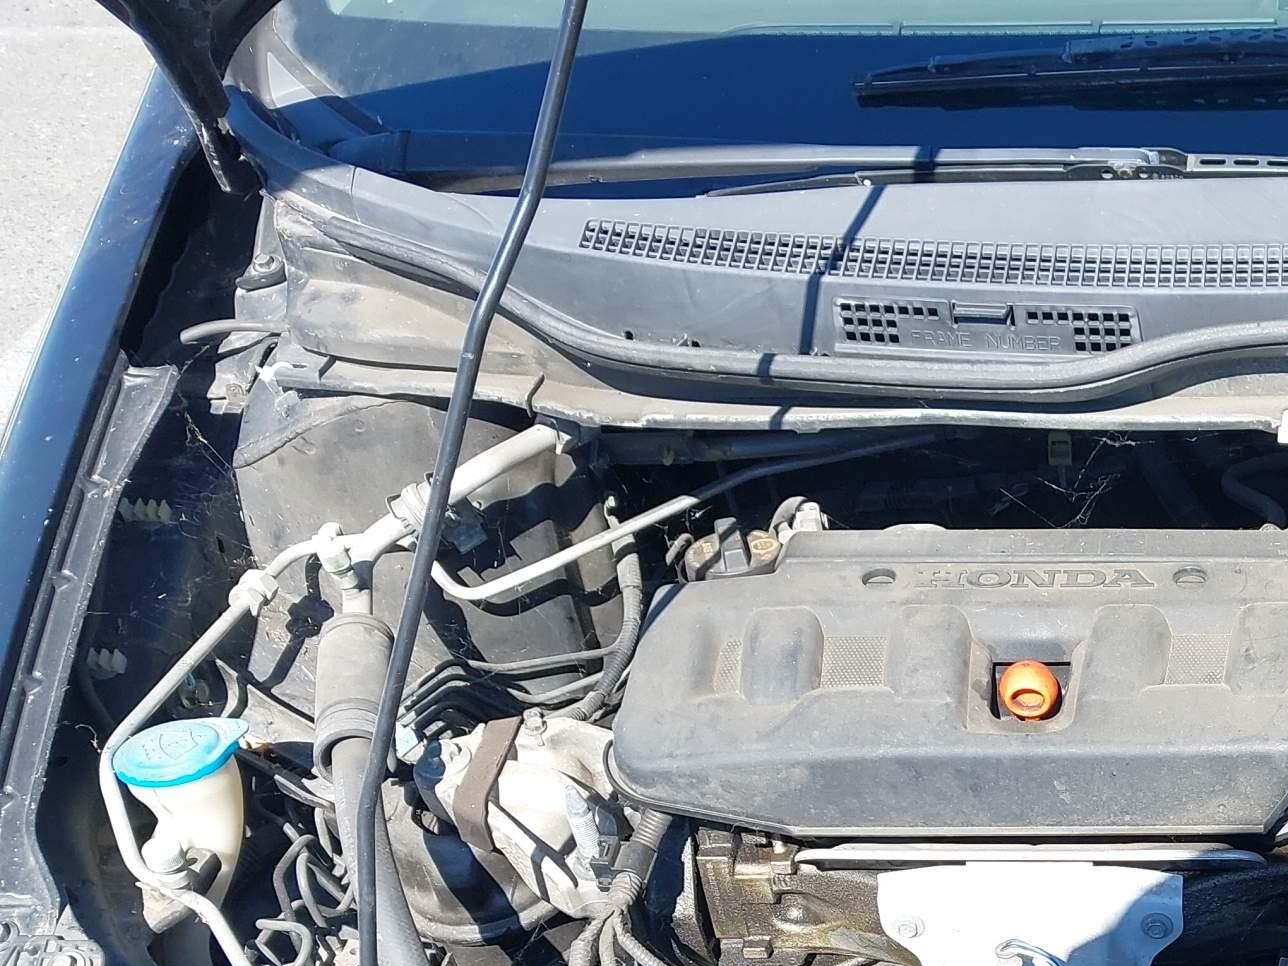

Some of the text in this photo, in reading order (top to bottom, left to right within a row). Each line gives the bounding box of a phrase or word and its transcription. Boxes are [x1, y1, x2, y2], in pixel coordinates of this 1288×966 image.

[911, 329, 1062, 352] FRAME NUMBER
[914, 567, 1156, 589] HONDA
